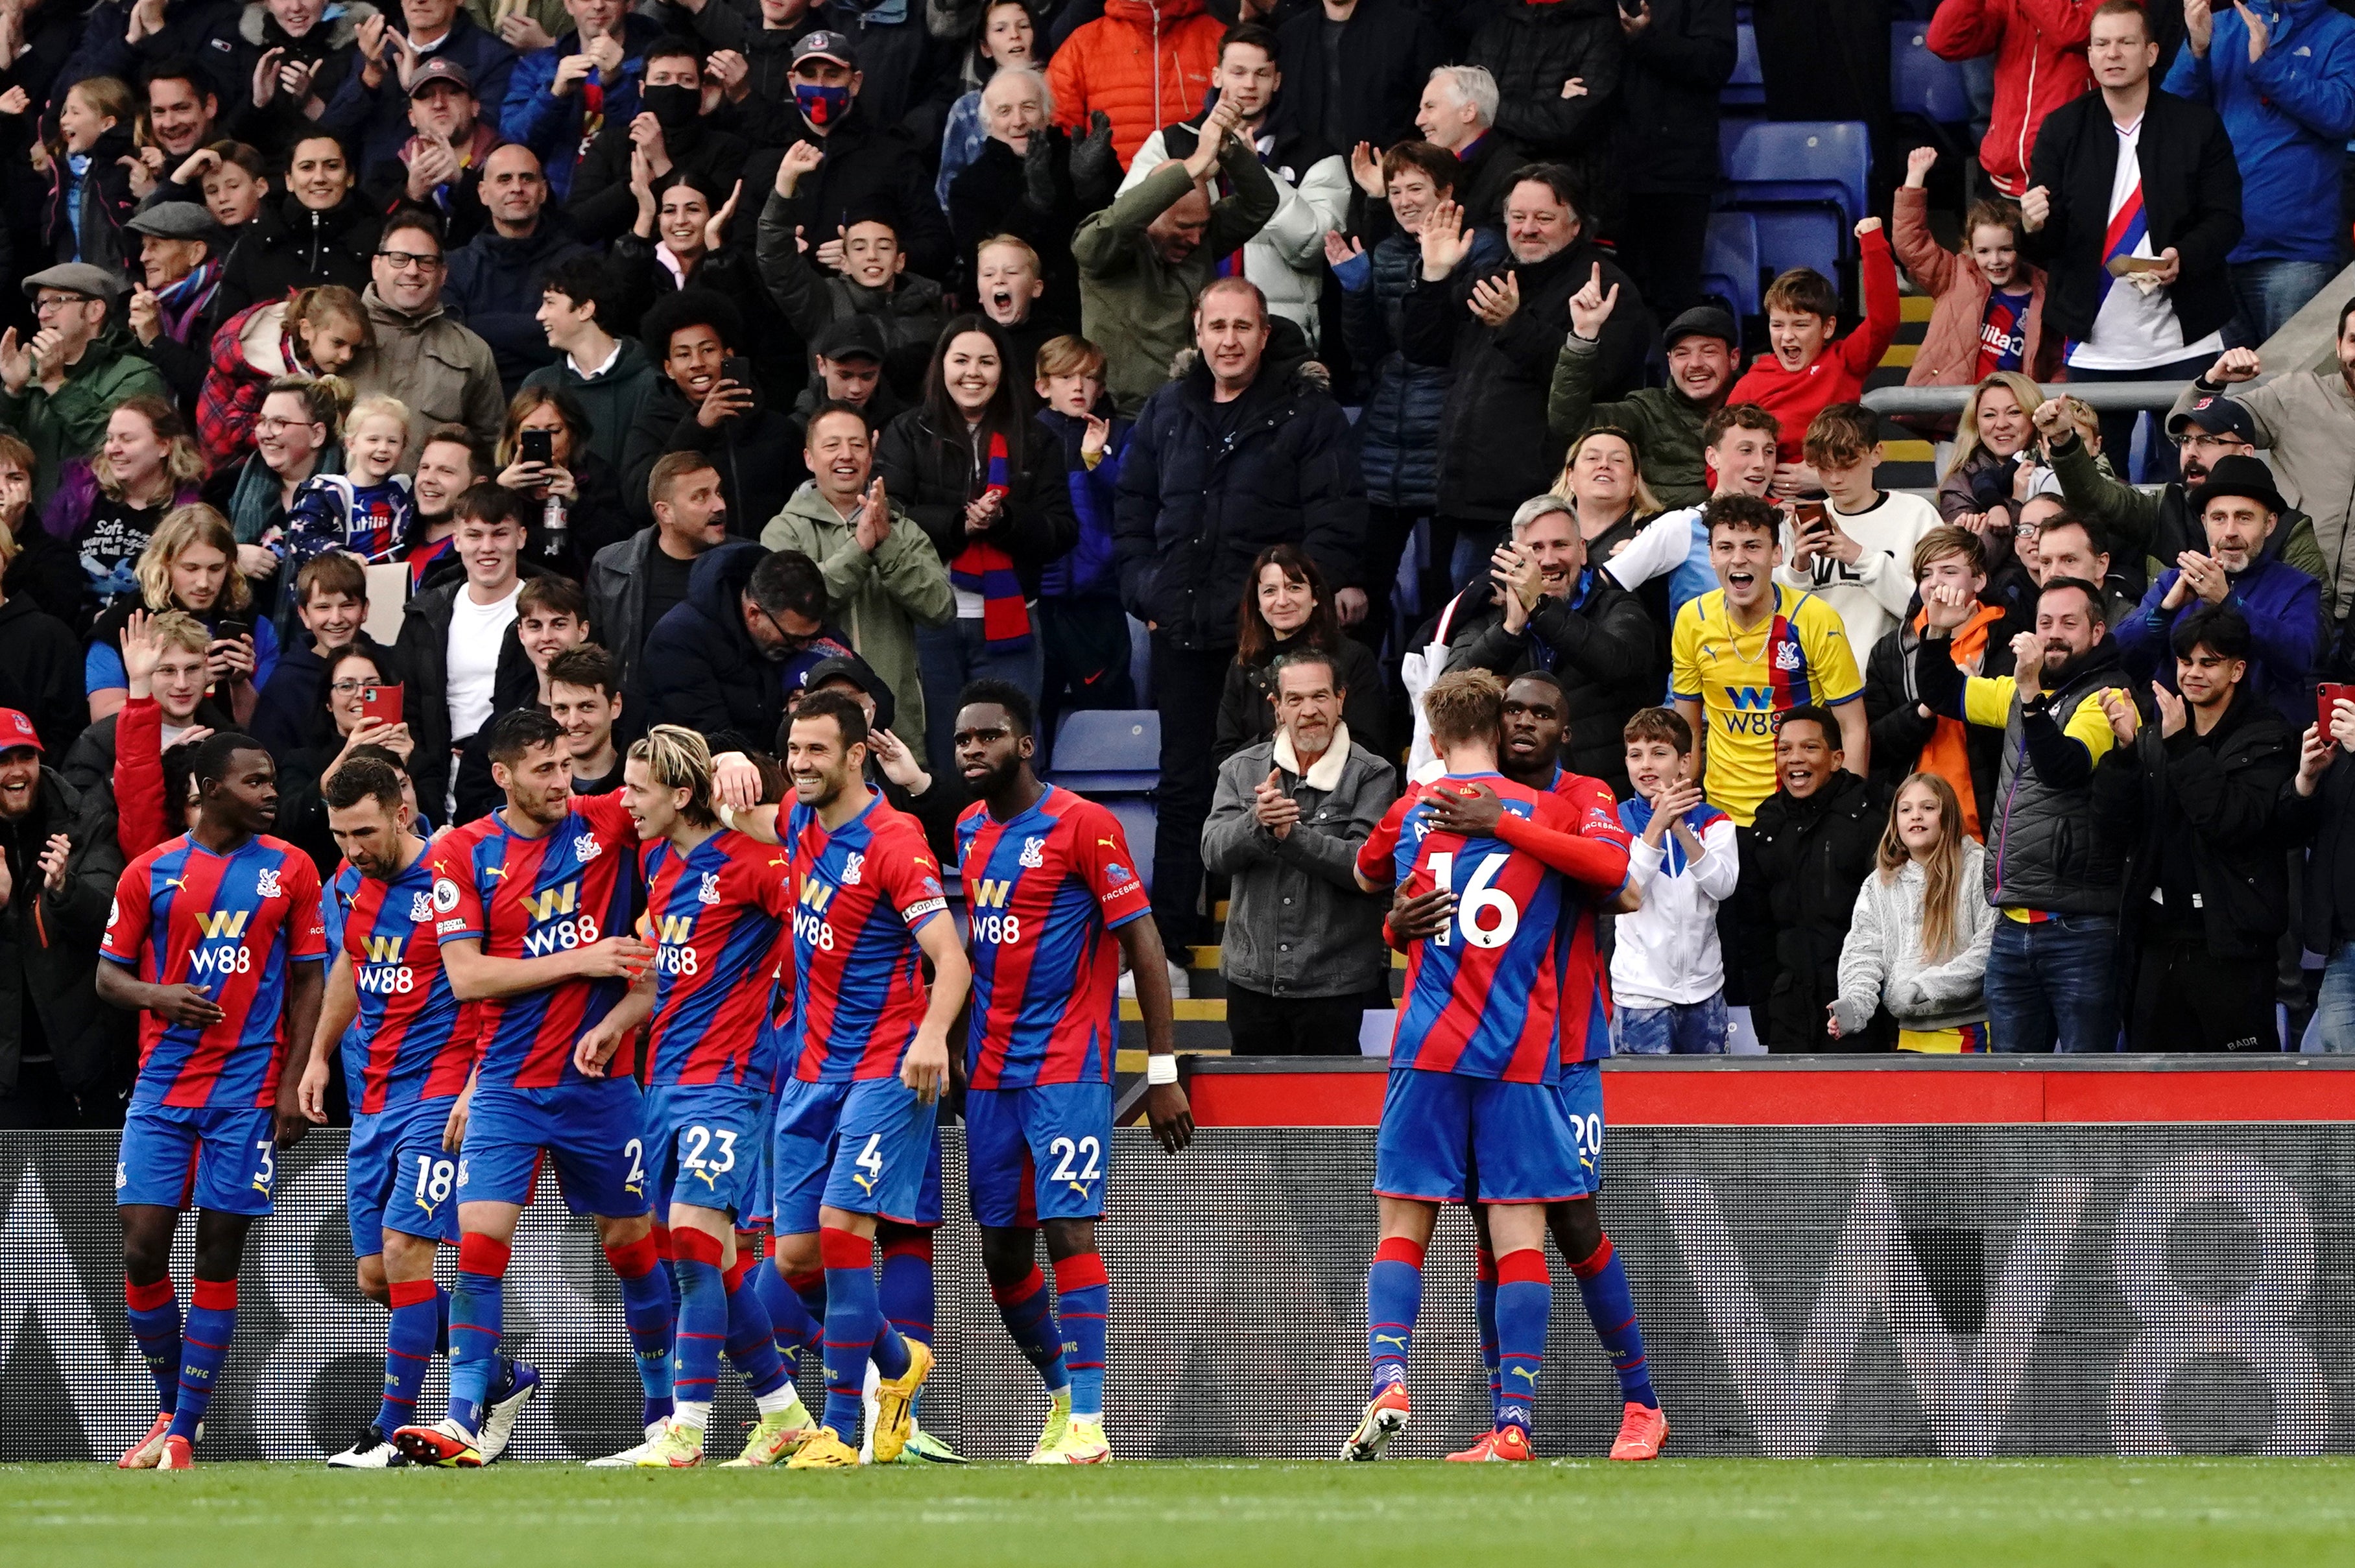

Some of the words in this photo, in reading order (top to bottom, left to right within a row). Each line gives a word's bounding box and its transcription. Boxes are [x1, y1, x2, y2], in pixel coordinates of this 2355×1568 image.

[1981, 323, 2011, 350] ilita
[94, 518, 124, 536] Soft
[1427, 852, 1519, 949] 16
[522, 915, 599, 958] W88
[794, 906, 835, 951] W88
[973, 915, 1020, 944] W88
[189, 945, 250, 974] W88
[357, 966, 414, 994] W88
[683, 1126, 738, 1172] 23
[855, 1133, 883, 1178] 4
[1570, 1113, 1602, 1156] 20
[254, 1141, 273, 1183] 3
[415, 1155, 455, 1202] 18
[625, 1138, 645, 1183] 2
[1051, 1136, 1101, 1181] 22
[185, 1364, 209, 1379] CPFC
